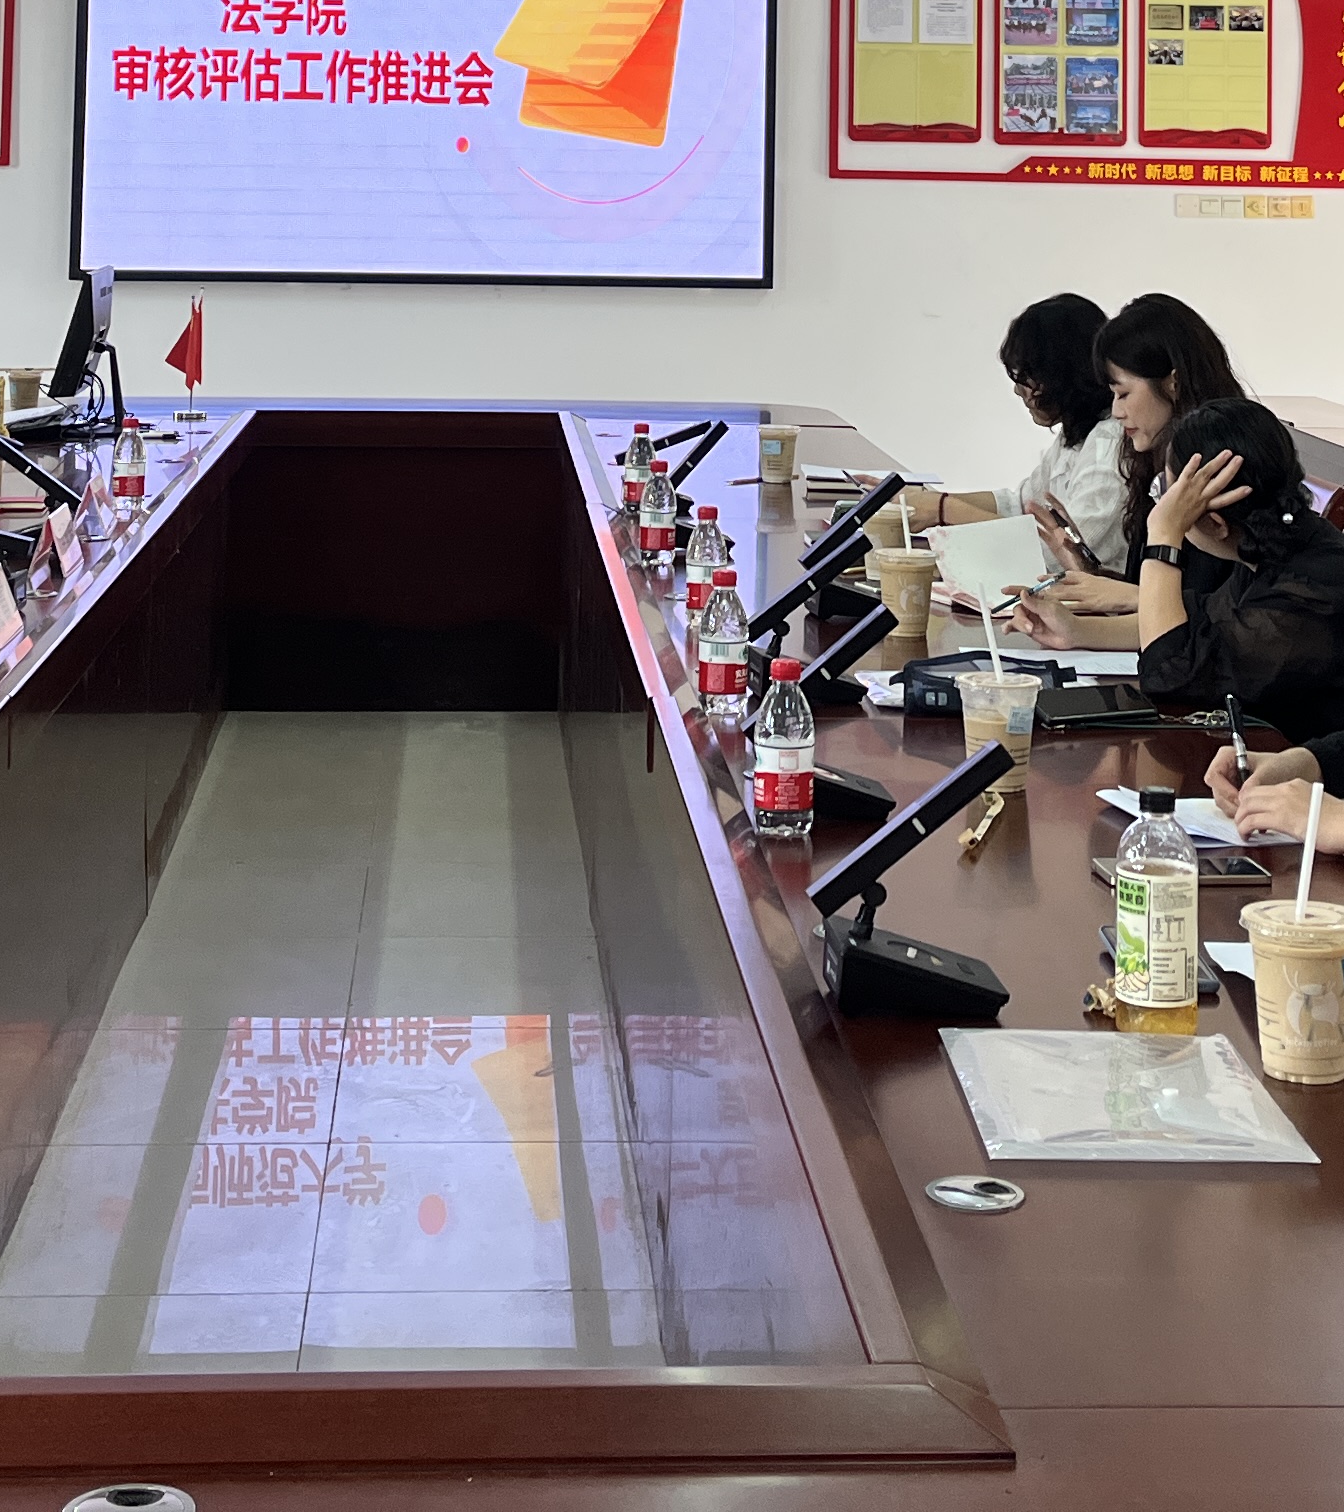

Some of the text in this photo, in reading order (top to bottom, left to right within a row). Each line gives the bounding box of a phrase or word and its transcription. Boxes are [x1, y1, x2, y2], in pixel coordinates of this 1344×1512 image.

[112, 44, 495, 106] 审核评估工作推进会
[1087, 162, 1310, 184] 新时代 新思想 新目标 新征程
